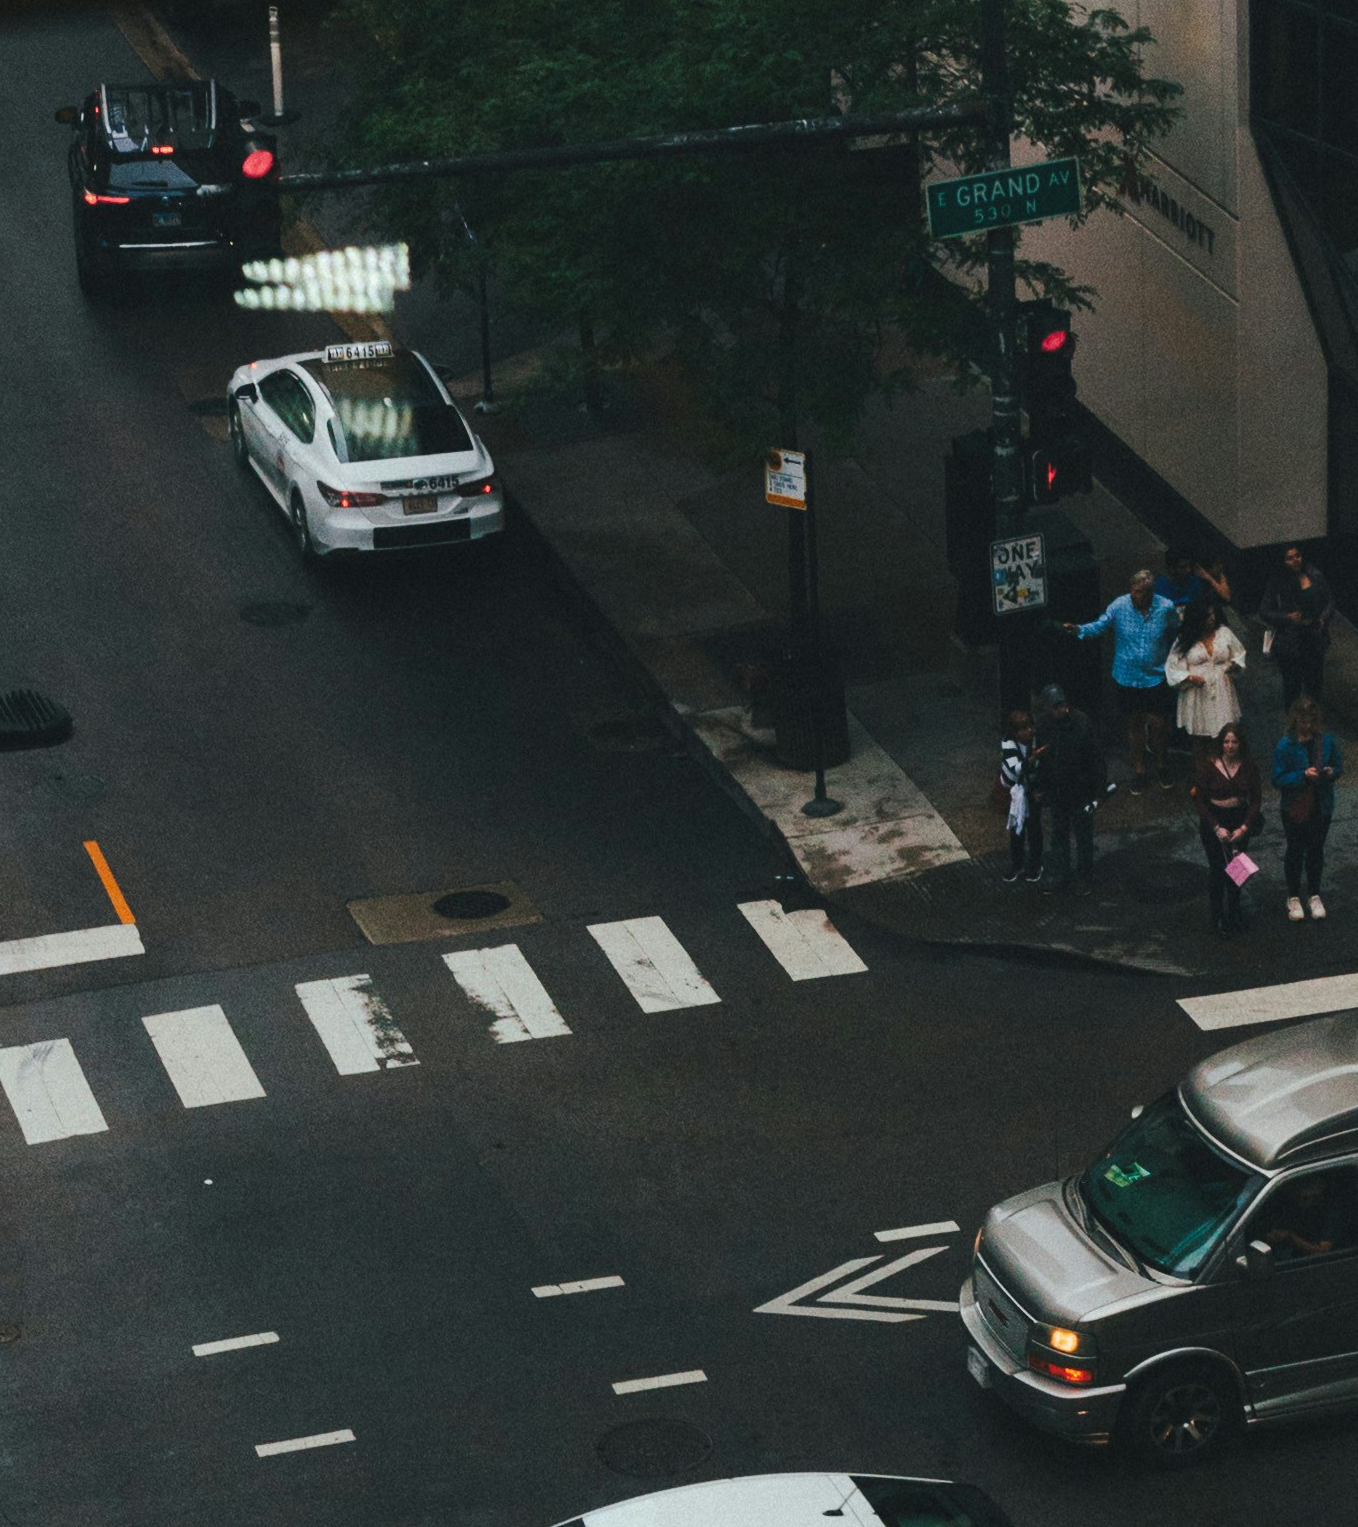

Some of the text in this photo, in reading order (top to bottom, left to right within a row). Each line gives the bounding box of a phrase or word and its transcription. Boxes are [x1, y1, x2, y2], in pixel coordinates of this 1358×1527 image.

[938, 170, 1070, 207] E GRAND AV
[974, 200, 1037, 223] 530 N
[346, 345, 374, 359] 6415
[429, 474, 460, 490] 6415
[997, 540, 1037, 564] ONE
